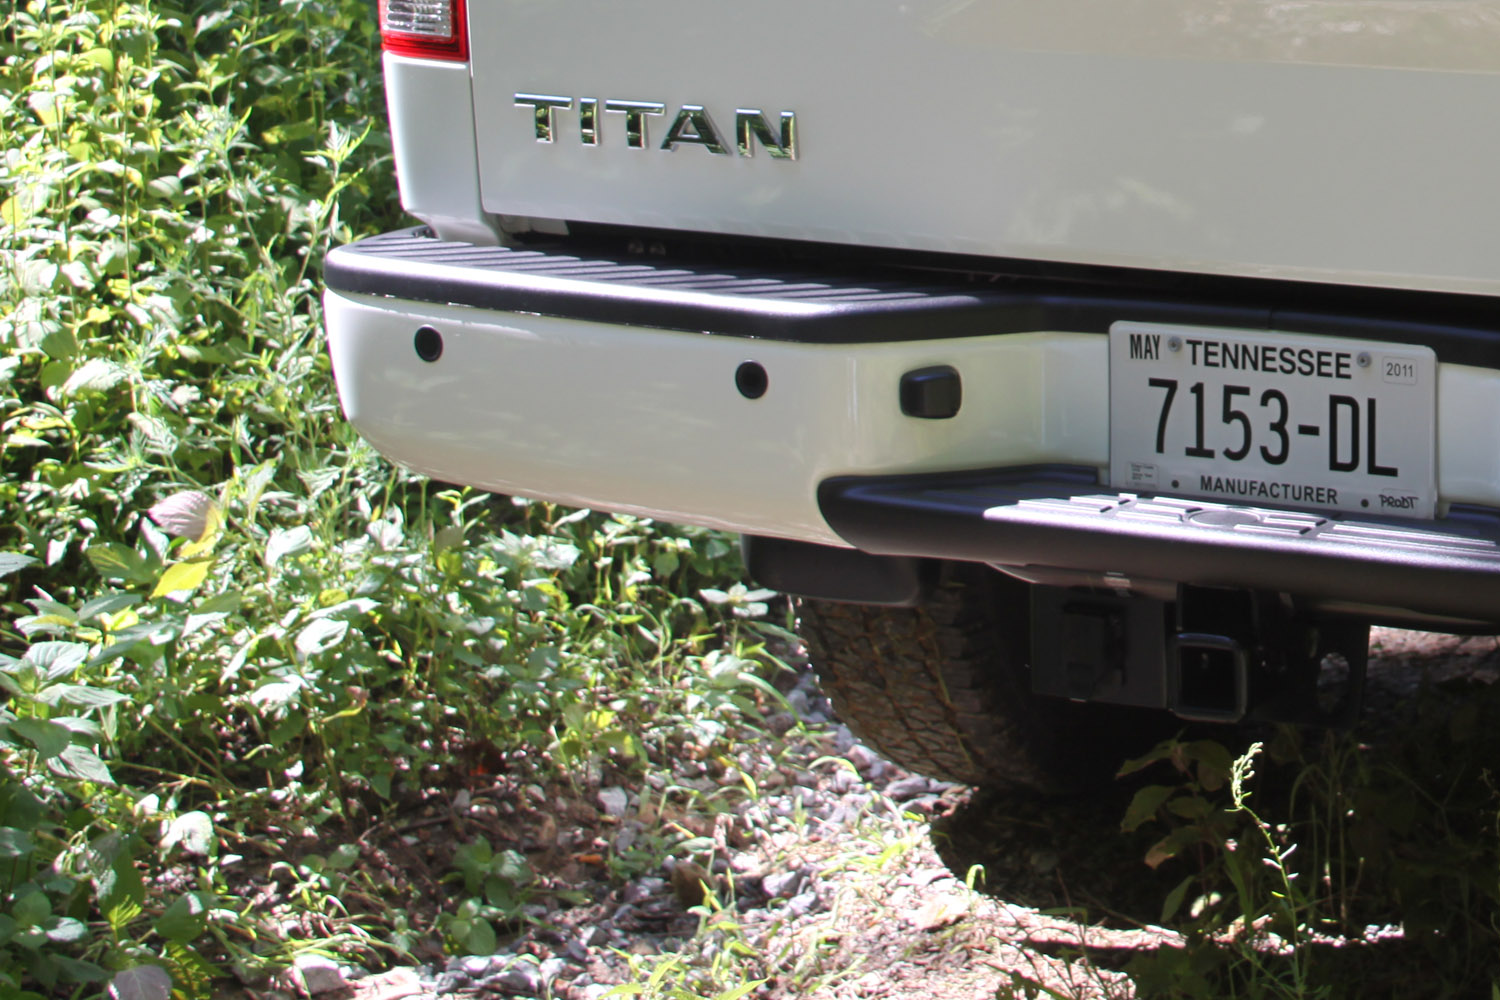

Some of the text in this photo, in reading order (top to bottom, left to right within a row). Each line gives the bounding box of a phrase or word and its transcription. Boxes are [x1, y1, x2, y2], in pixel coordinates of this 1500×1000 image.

[513, 92, 800, 161] TITAN
[1129, 333, 1353, 380] MAY TENNESSEE
[1386, 361, 1415, 379] 2011
[1148, 377, 1399, 478] 7153-DL
[1200, 474, 1338, 505] MANUFACTURER
